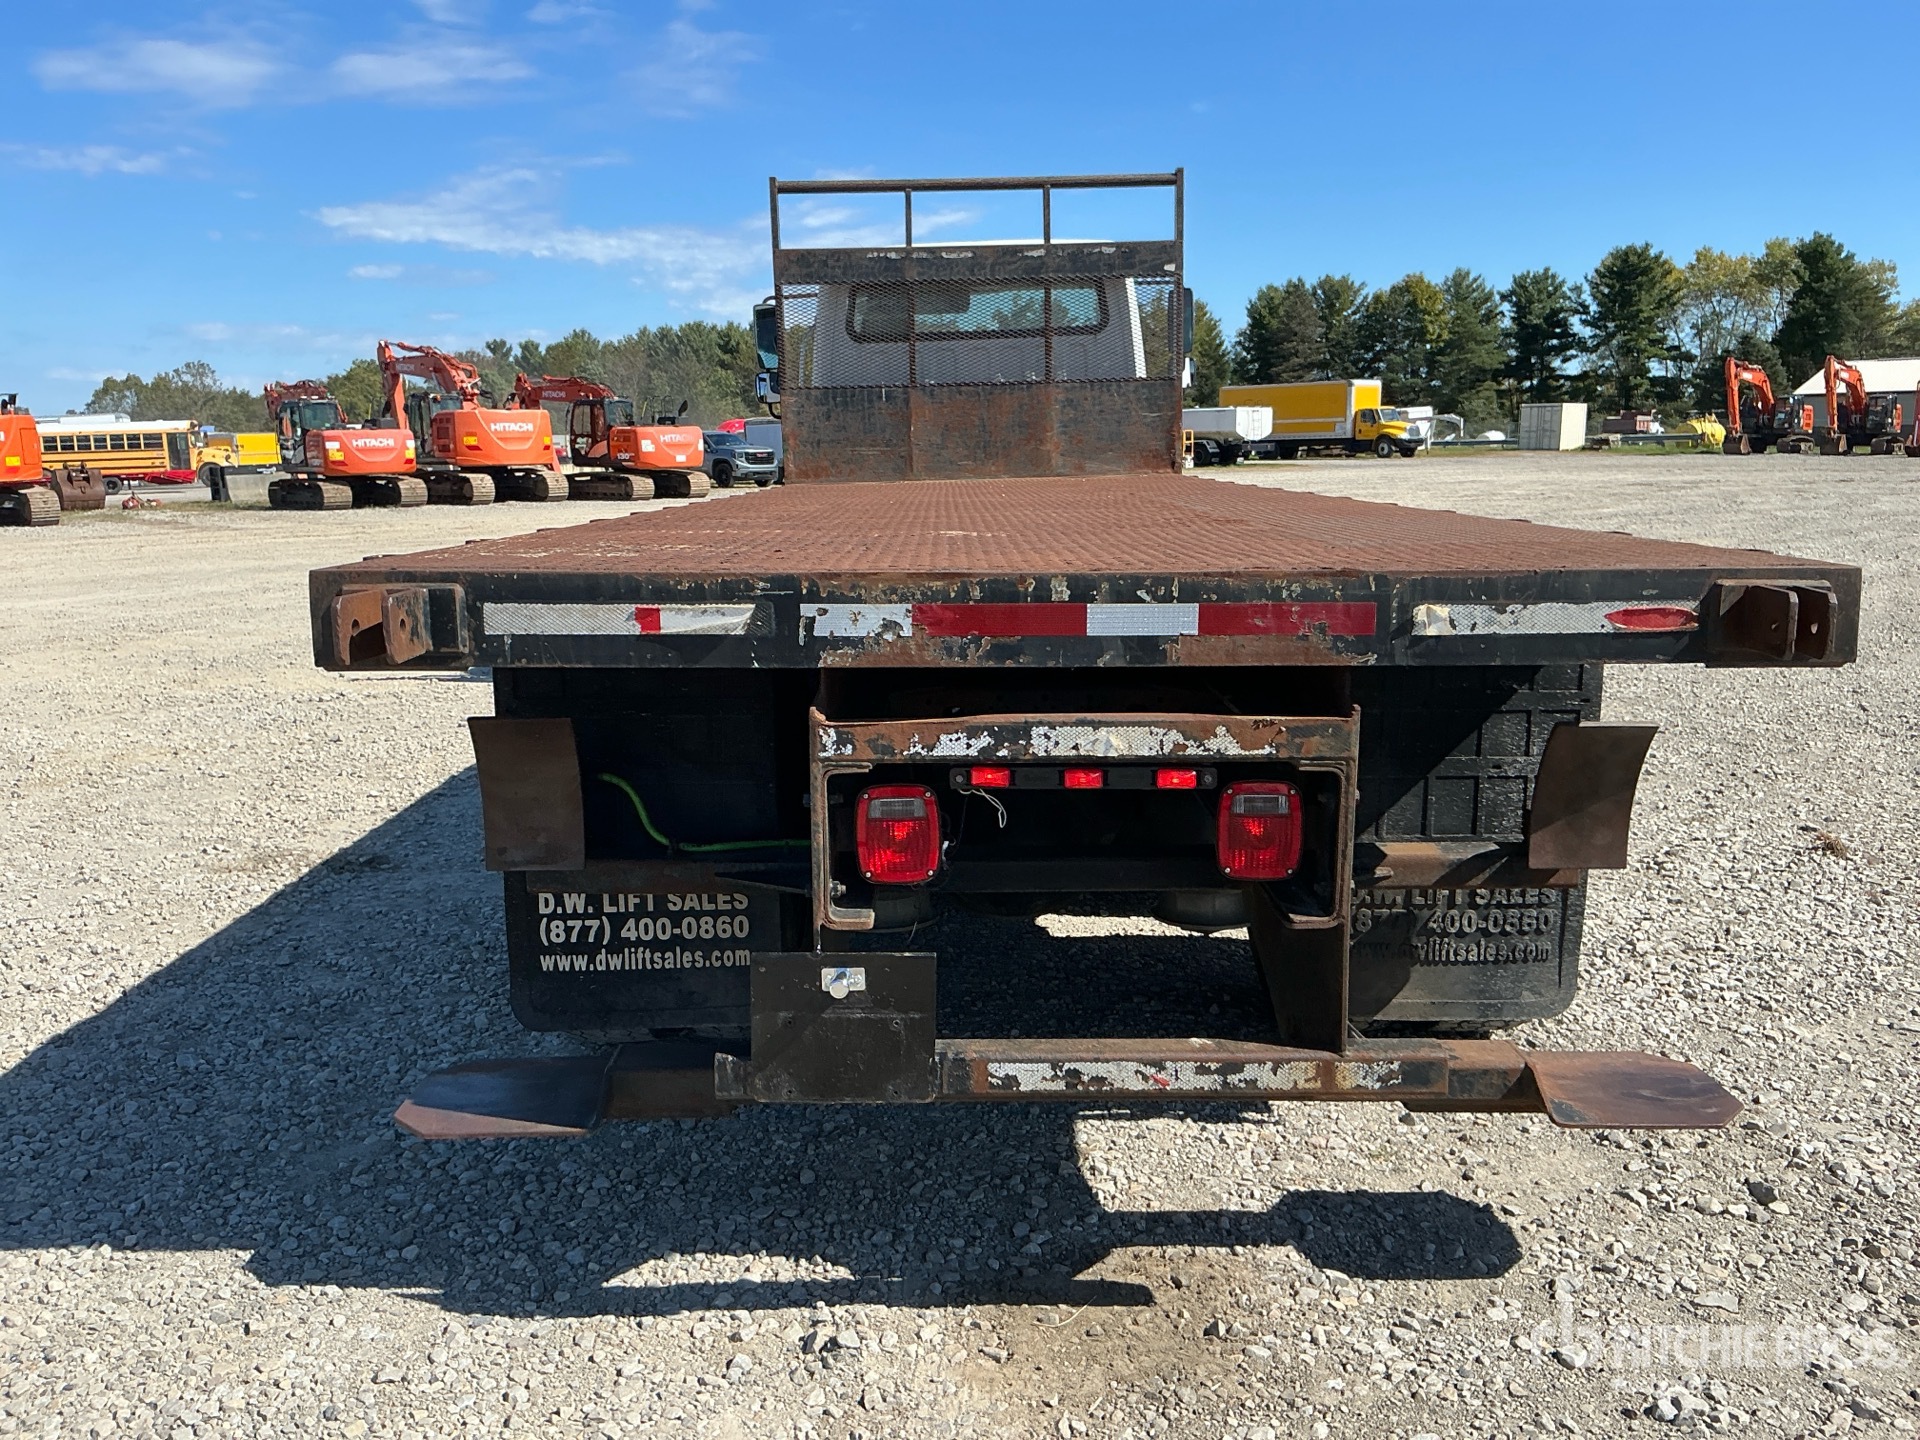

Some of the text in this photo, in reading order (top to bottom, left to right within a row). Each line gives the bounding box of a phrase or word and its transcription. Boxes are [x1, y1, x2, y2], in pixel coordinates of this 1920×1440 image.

[542, 390, 567, 398] HITACHI
[490, 422, 534, 432] HITACHI
[351, 438, 395, 448] HITACHI
[660, 434, 694, 443] HITAC
[538, 892, 749, 914] D.W. LIFT SALES
[539, 915, 750, 946] (877) 400-0860
[539, 946, 751, 972] www.dwliftsales.com
